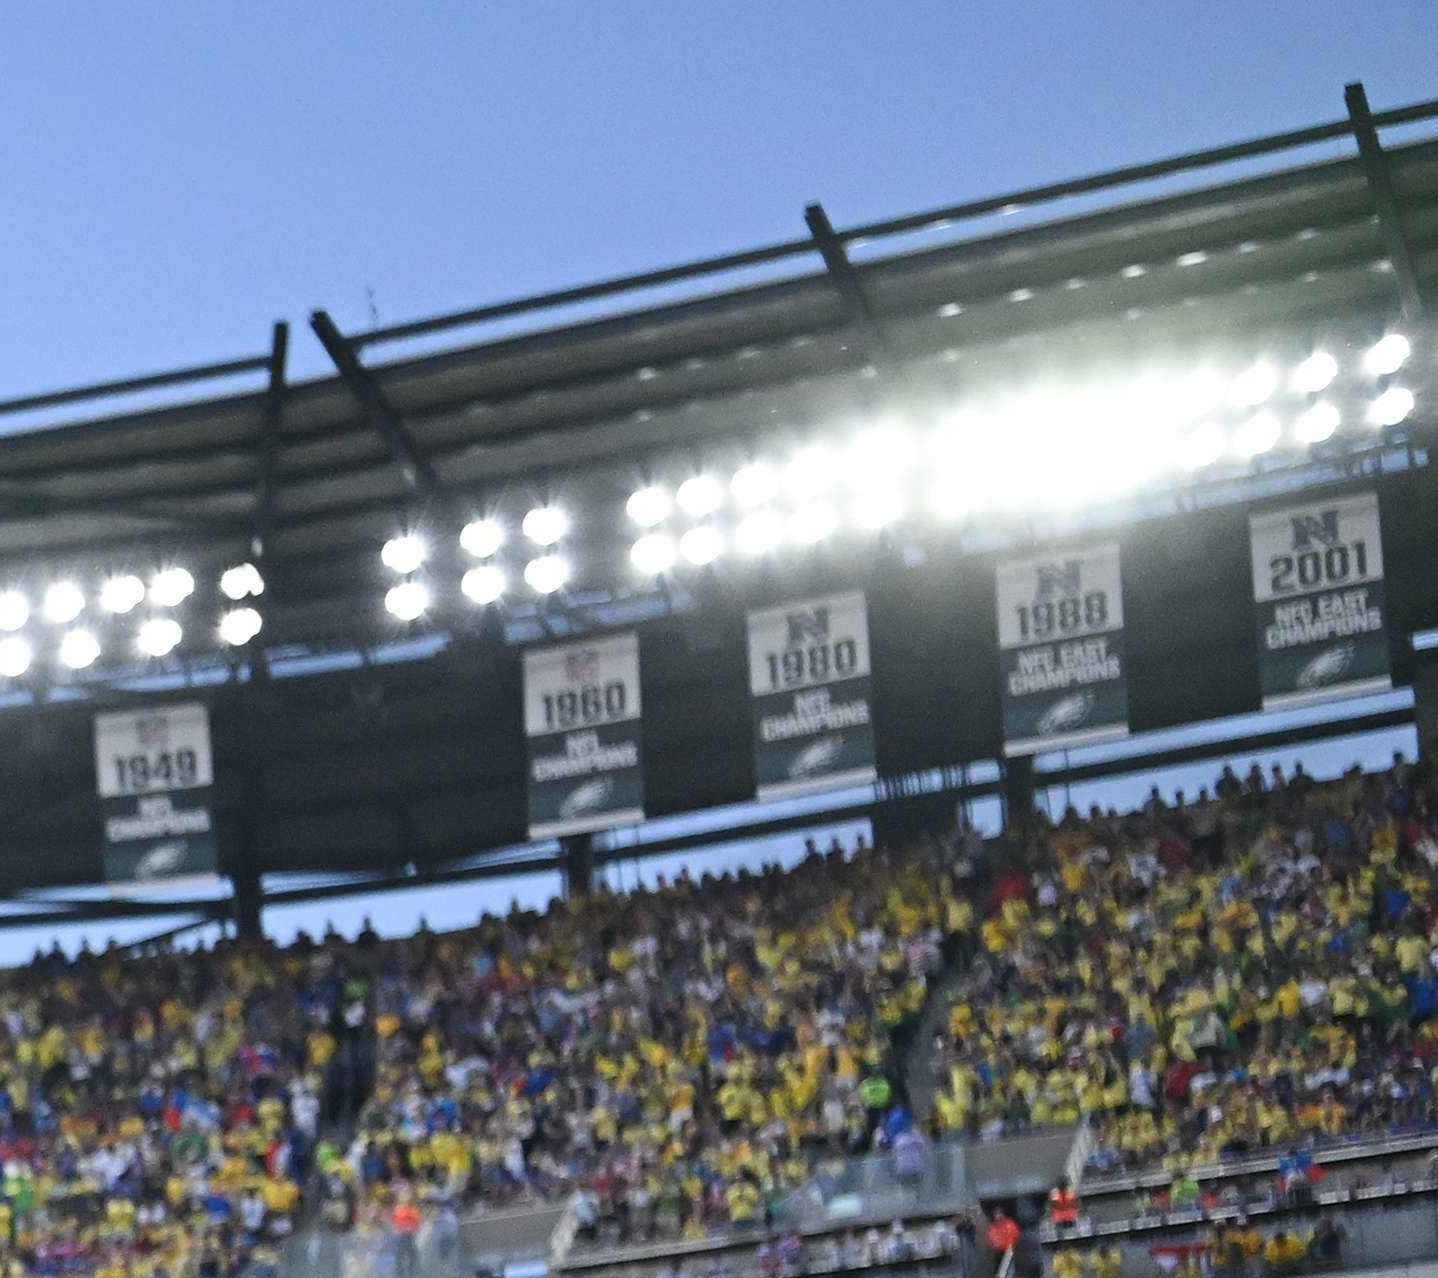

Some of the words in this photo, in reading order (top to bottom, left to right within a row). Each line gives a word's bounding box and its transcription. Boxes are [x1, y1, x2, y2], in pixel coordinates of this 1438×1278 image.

[1270, 541, 1368, 594] 2001
[1015, 591, 1109, 640] 1988
[543, 677, 627, 730] 1960
